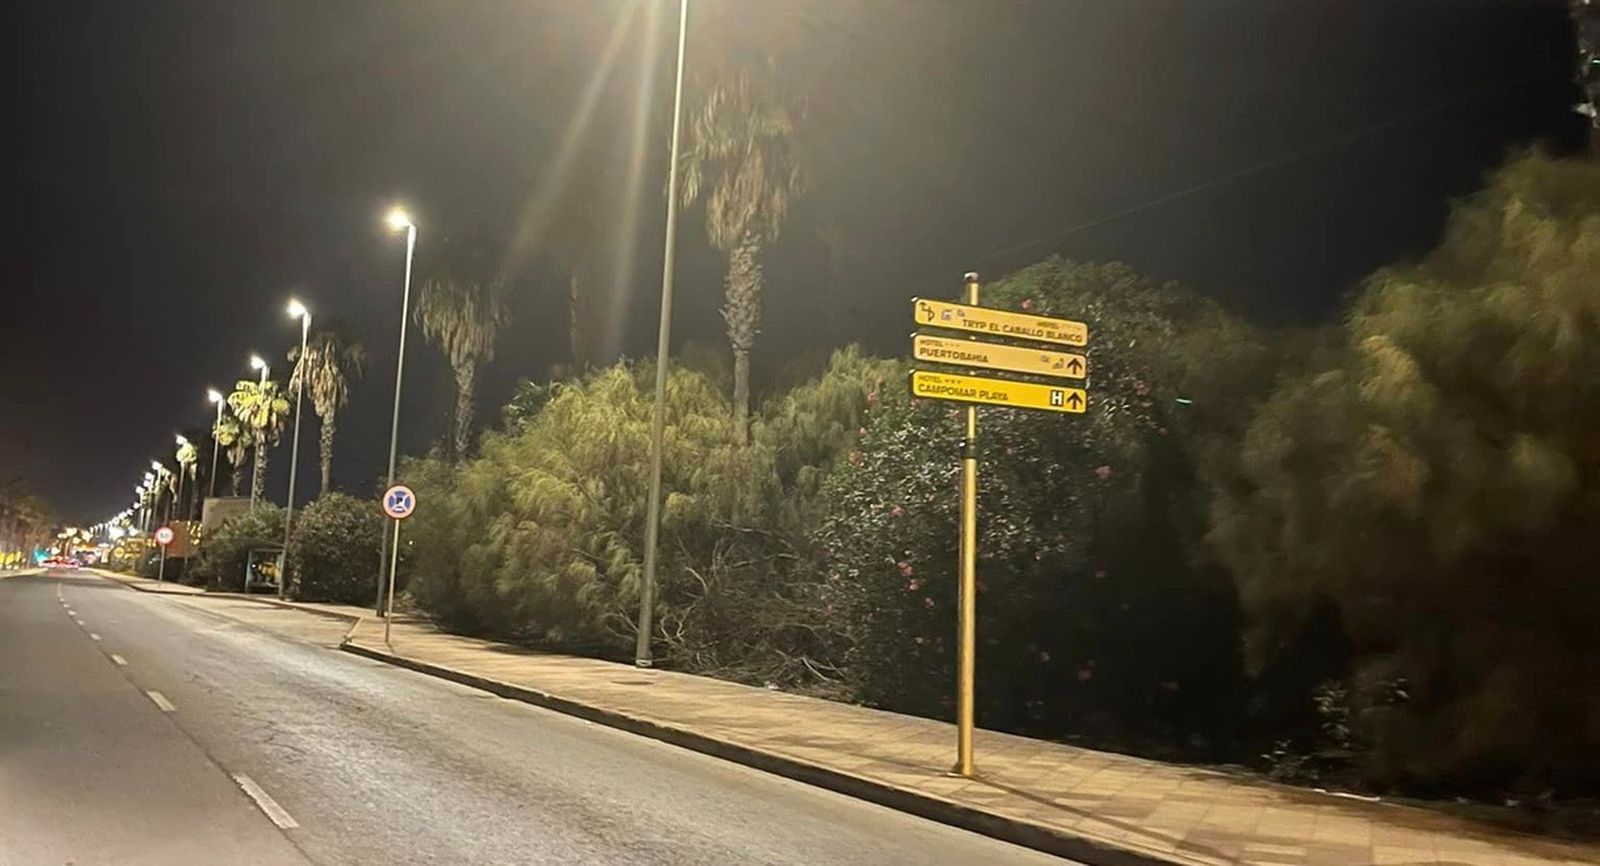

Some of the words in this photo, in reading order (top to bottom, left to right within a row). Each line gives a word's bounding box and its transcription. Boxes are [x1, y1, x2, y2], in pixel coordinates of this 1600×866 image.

[962, 319, 986, 329] TRYP
[989, 322, 1000, 331] EL
[1002, 324, 1043, 337] CABALLO
[1046, 330, 1082, 343] BLANCO
[919, 339, 943, 347] HOTEL
[918, 375, 942, 383] HOTEL
[918, 383, 976, 396] CAMPOMAR
[979, 390, 1008, 401] PLAYA
[1051, 391, 1063, 405] H
